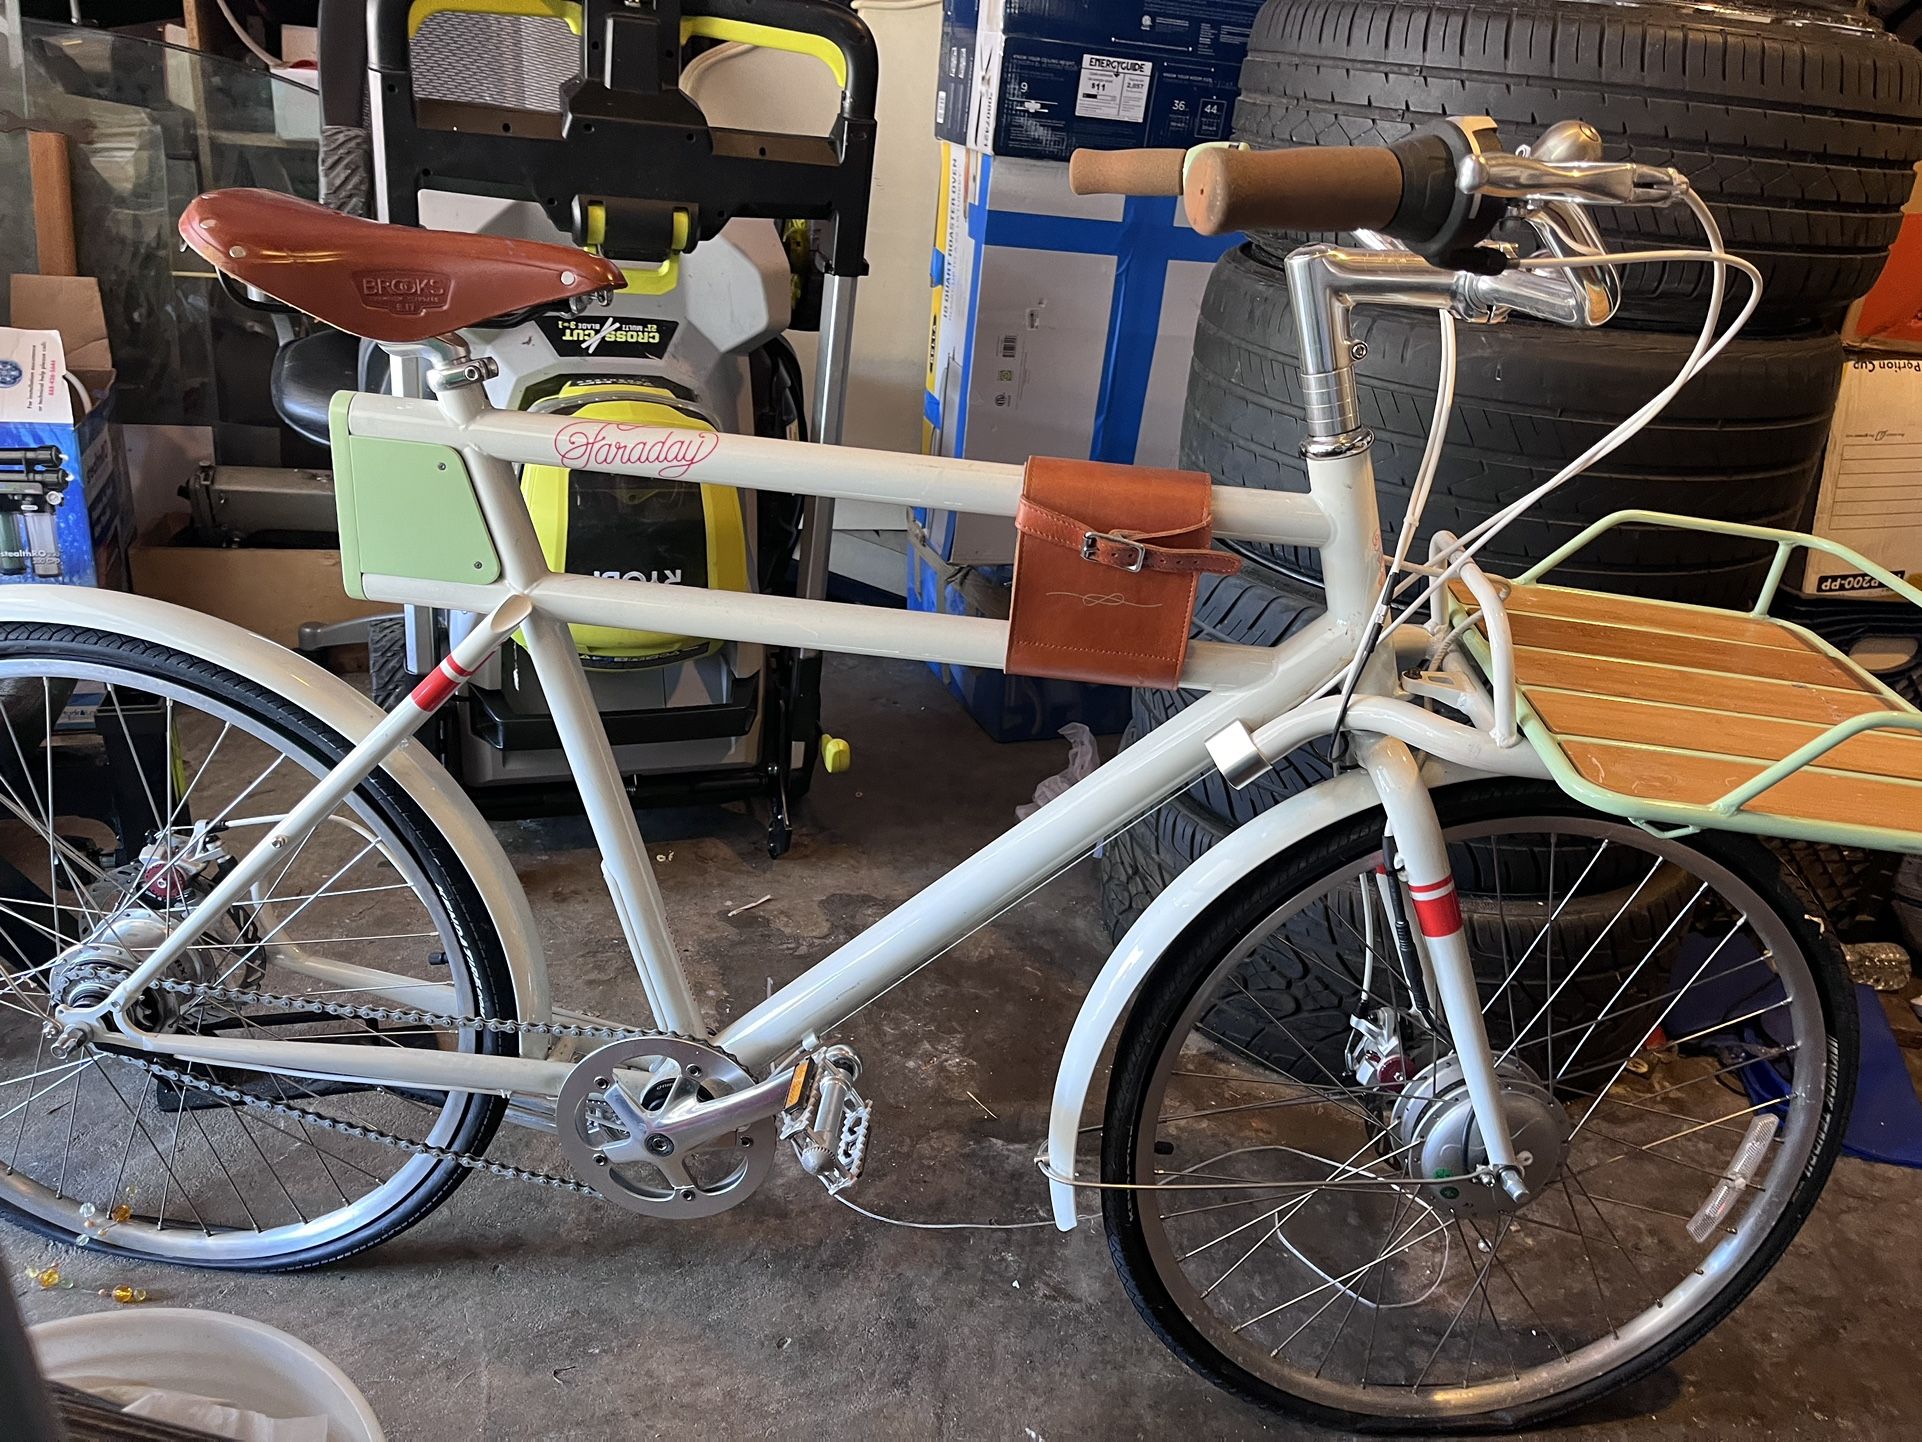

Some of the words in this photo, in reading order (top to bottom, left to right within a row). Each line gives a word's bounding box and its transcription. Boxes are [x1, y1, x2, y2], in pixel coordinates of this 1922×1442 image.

[1172, 100, 1186, 111] 36
[1204, 104, 1218, 114] 44
[948, 205, 956, 257] ROASTER
[362, 278, 445, 295] BROOKS
[562, 329, 596, 341] CUT
[605, 331, 660, 343] CROSS
[1853, 360, 1876, 373] Cup
[1879, 360, 1921, 373] Portion
[554, 420, 720, 478] Faraday
